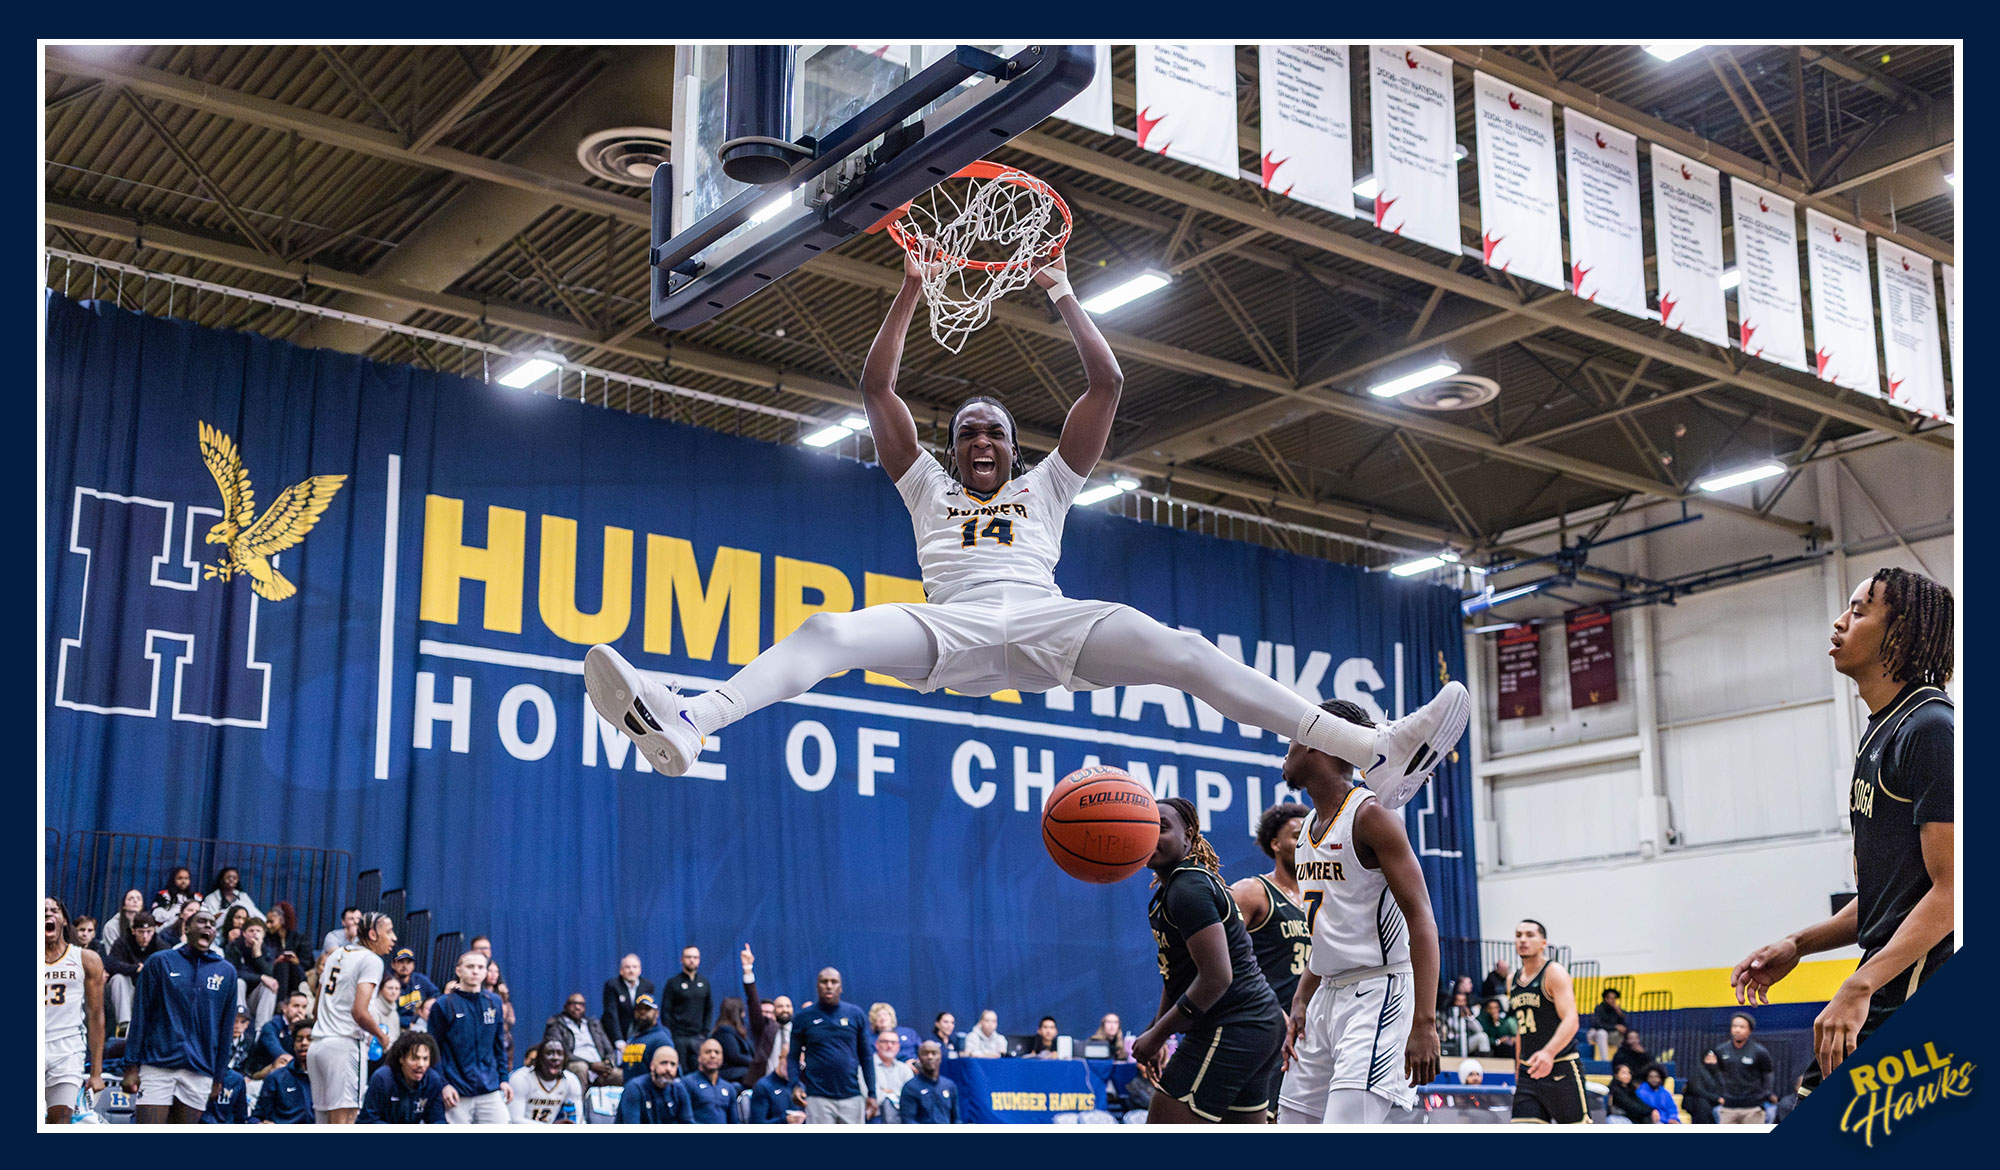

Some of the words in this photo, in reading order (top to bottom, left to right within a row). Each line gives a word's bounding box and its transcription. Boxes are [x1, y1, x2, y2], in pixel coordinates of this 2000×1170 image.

[961, 516, 1016, 550] 14
[785, 718, 900, 796] OF
[1080, 790, 1151, 808] EVOLUTION
[1303, 889, 1324, 937] 7
[45, 983, 67, 1006] 3
[325, 967, 341, 996] 5
[1515, 1008, 1537, 1035] 24
[991, 1092, 1047, 1111] HUMBER
[1049, 1092, 1096, 1111] HAWKS
